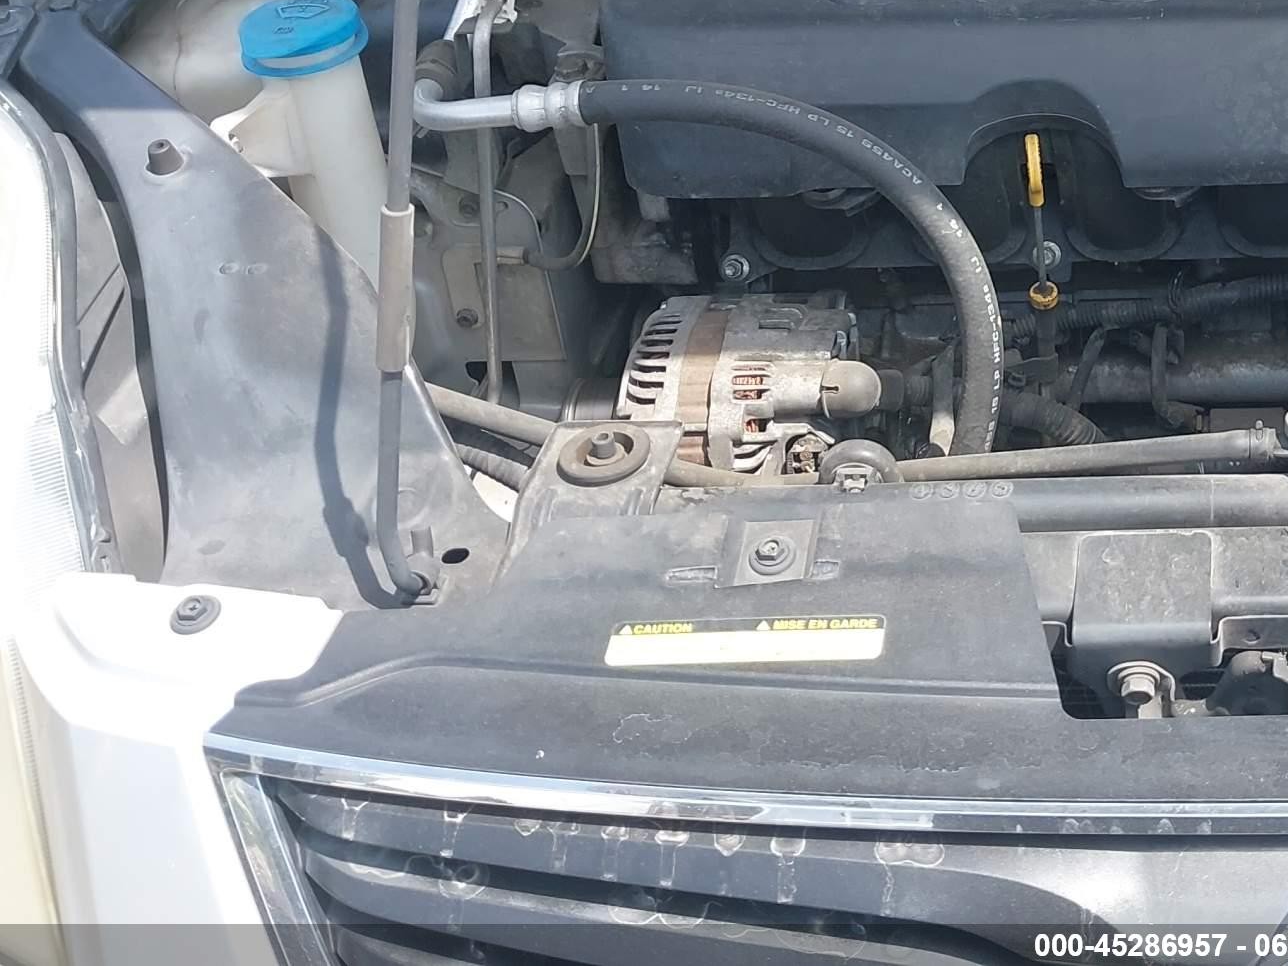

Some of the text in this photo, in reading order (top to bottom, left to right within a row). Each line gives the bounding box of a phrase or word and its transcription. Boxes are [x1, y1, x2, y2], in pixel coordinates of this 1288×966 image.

[807, 113, 830, 126] LP
[836, 125, 855, 138] 15
[633, 622, 693, 634] CAUTION
[772, 618, 878, 630] MISE EN GARDE
